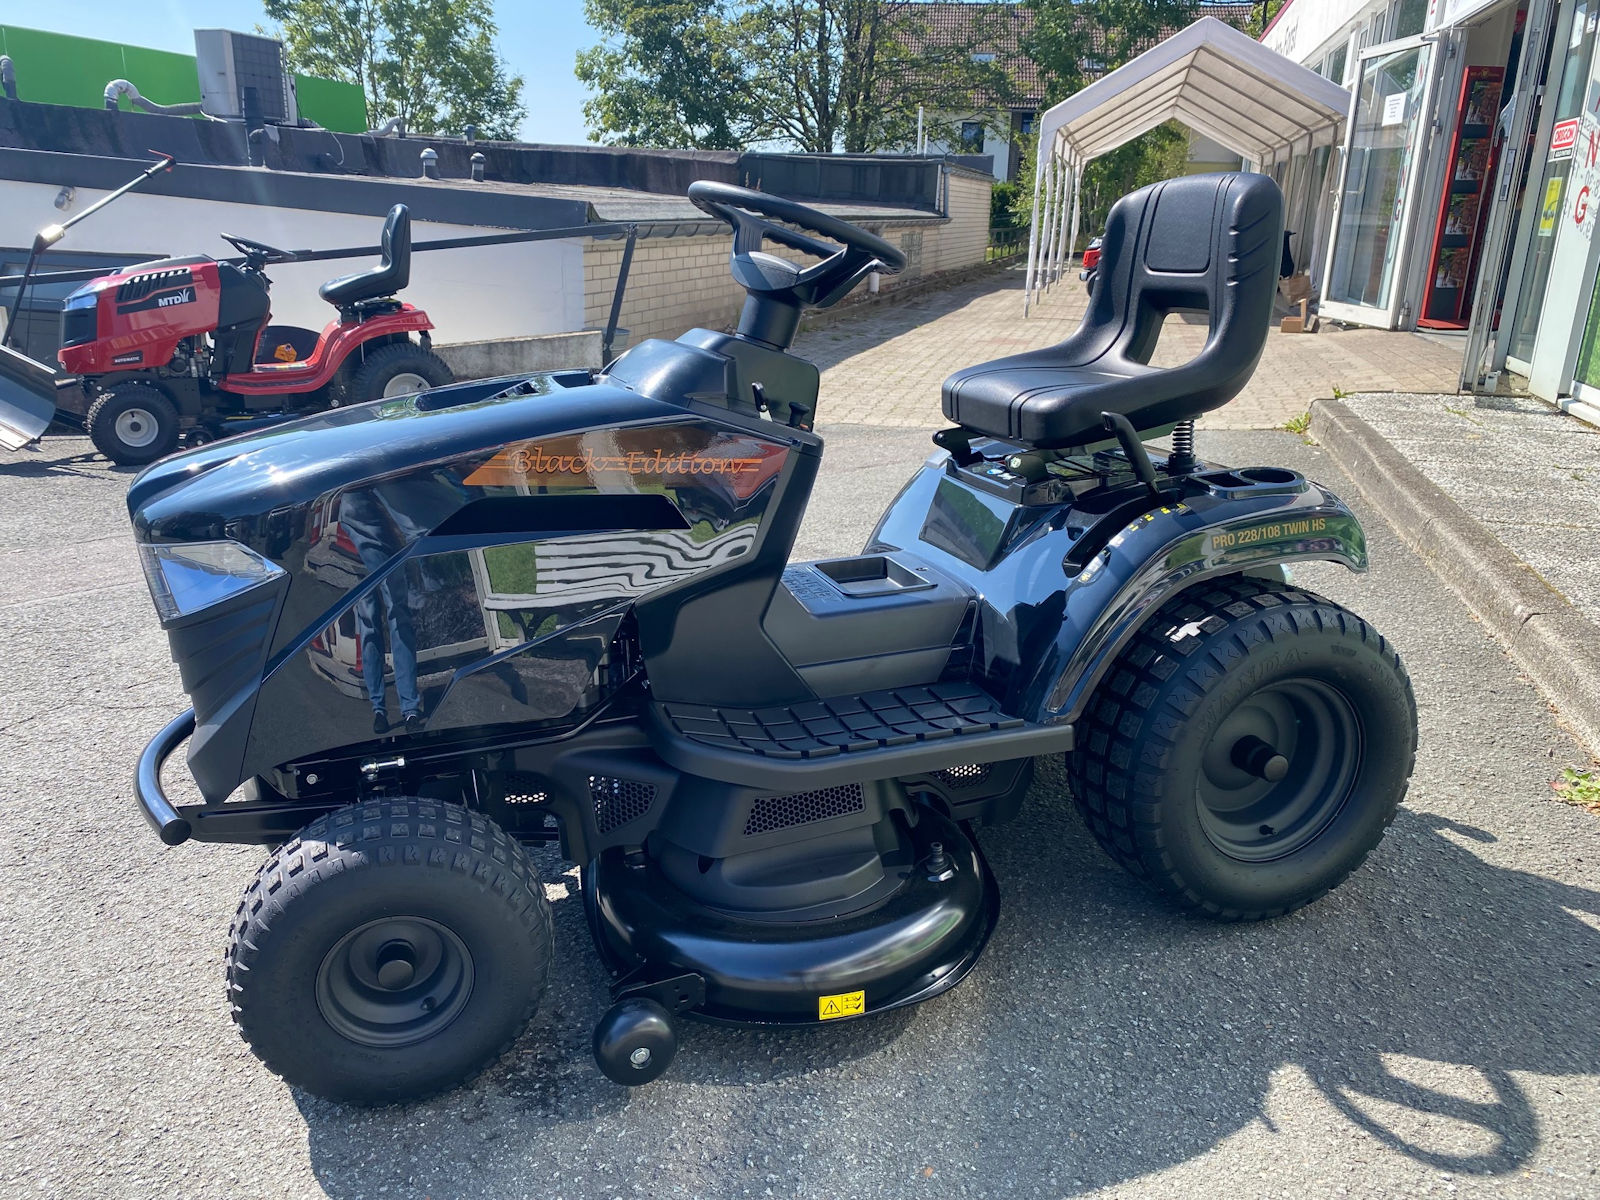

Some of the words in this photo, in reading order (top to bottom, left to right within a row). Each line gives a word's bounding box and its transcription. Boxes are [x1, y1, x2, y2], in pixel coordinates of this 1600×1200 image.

[158, 295, 182, 307] MTD
[510, 446, 608, 475] Black
[625, 448, 744, 476] Edition
[1212, 534, 1236, 549] PRO
[1238, 527, 1281, 545] 228/108
[1282, 519, 1310, 536] TWIN
[1312, 518, 1326, 532] HS
